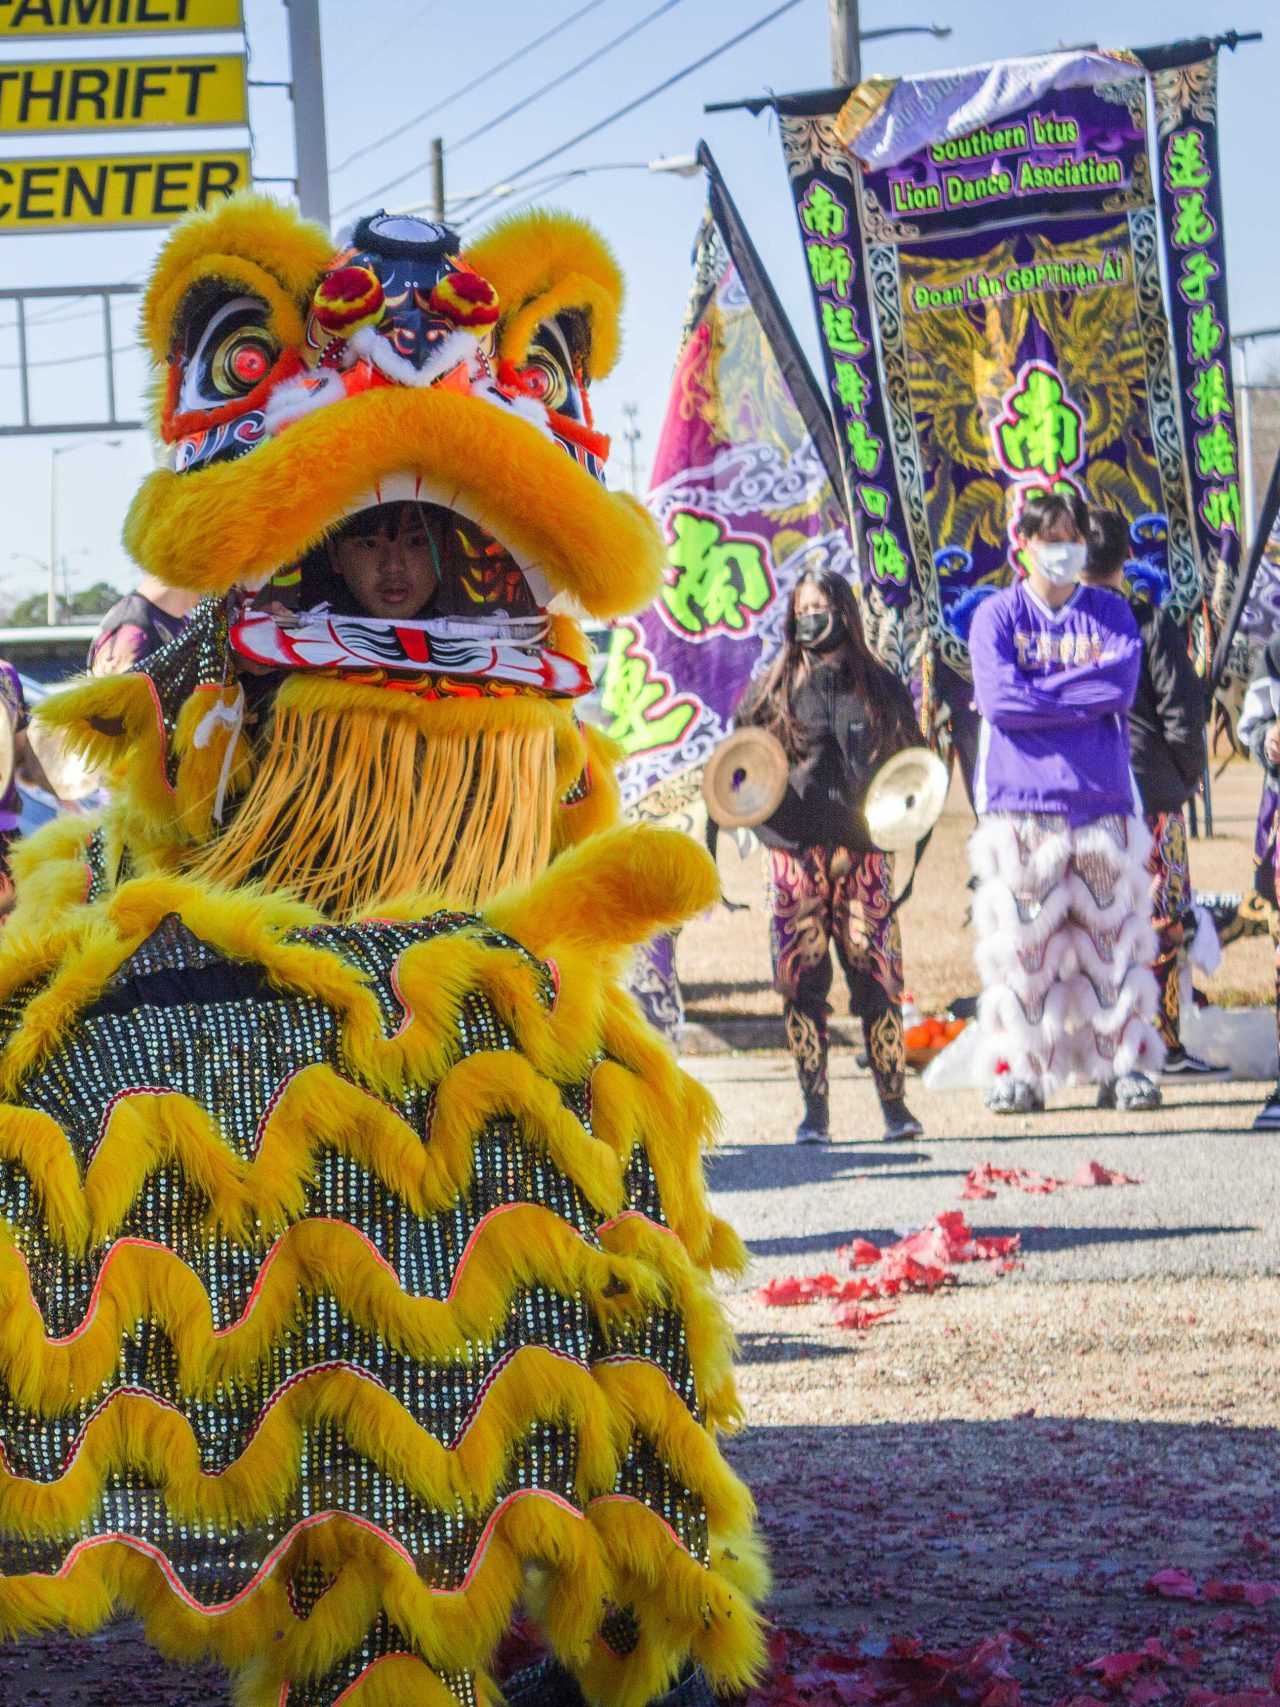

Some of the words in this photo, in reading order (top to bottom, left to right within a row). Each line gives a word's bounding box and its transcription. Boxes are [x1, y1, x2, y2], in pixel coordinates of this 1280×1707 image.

[931, 124, 1027, 162] Southern
[893, 181, 940, 212] Lion
[946, 172, 1012, 206] Dance
